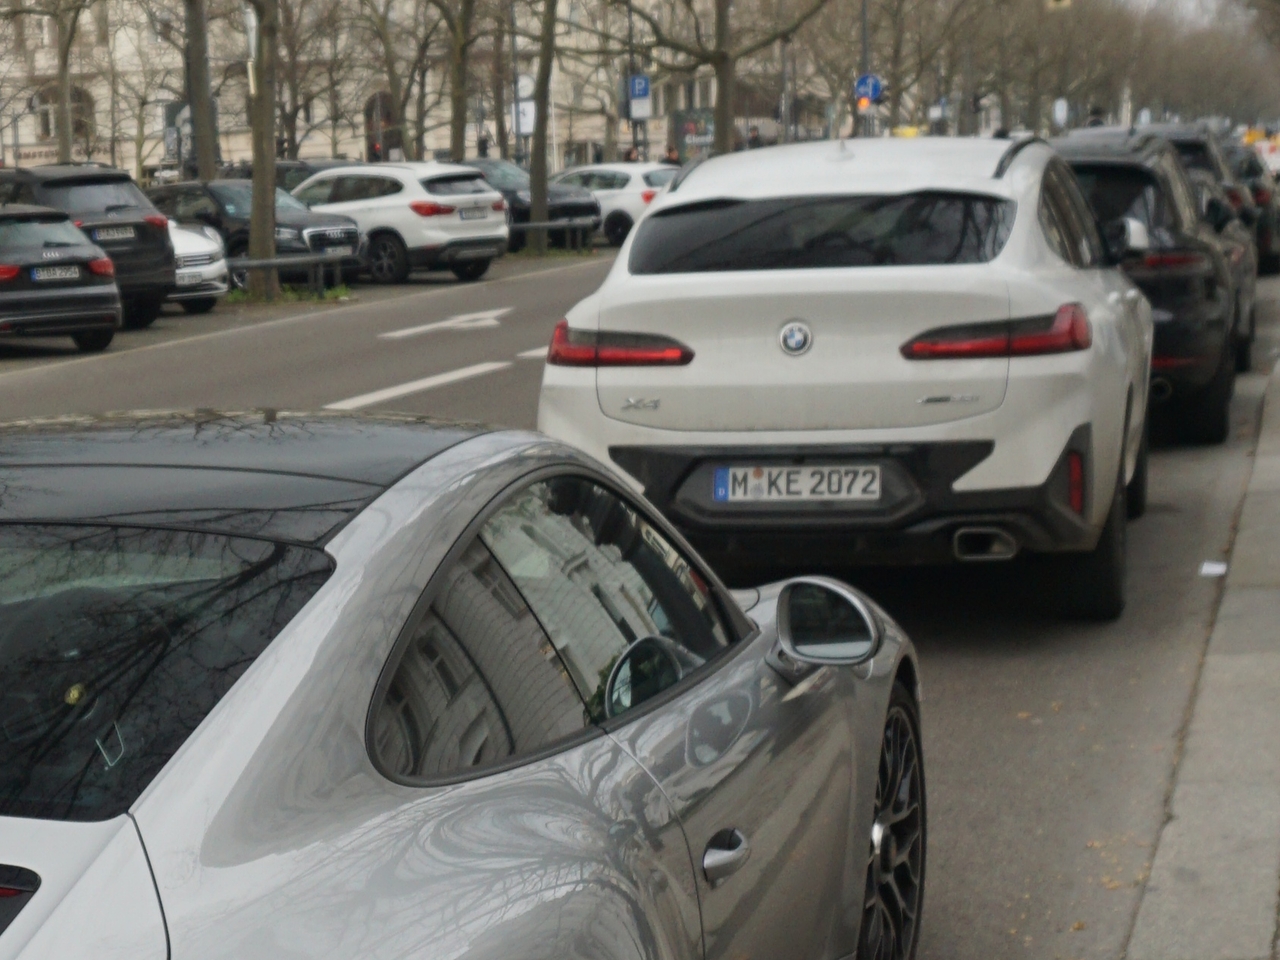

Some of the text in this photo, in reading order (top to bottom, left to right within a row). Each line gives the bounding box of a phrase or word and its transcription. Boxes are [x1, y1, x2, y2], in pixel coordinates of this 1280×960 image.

[731, 471, 748, 497] M
[767, 470, 802, 496] KE
[809, 469, 877, 496] 2072
